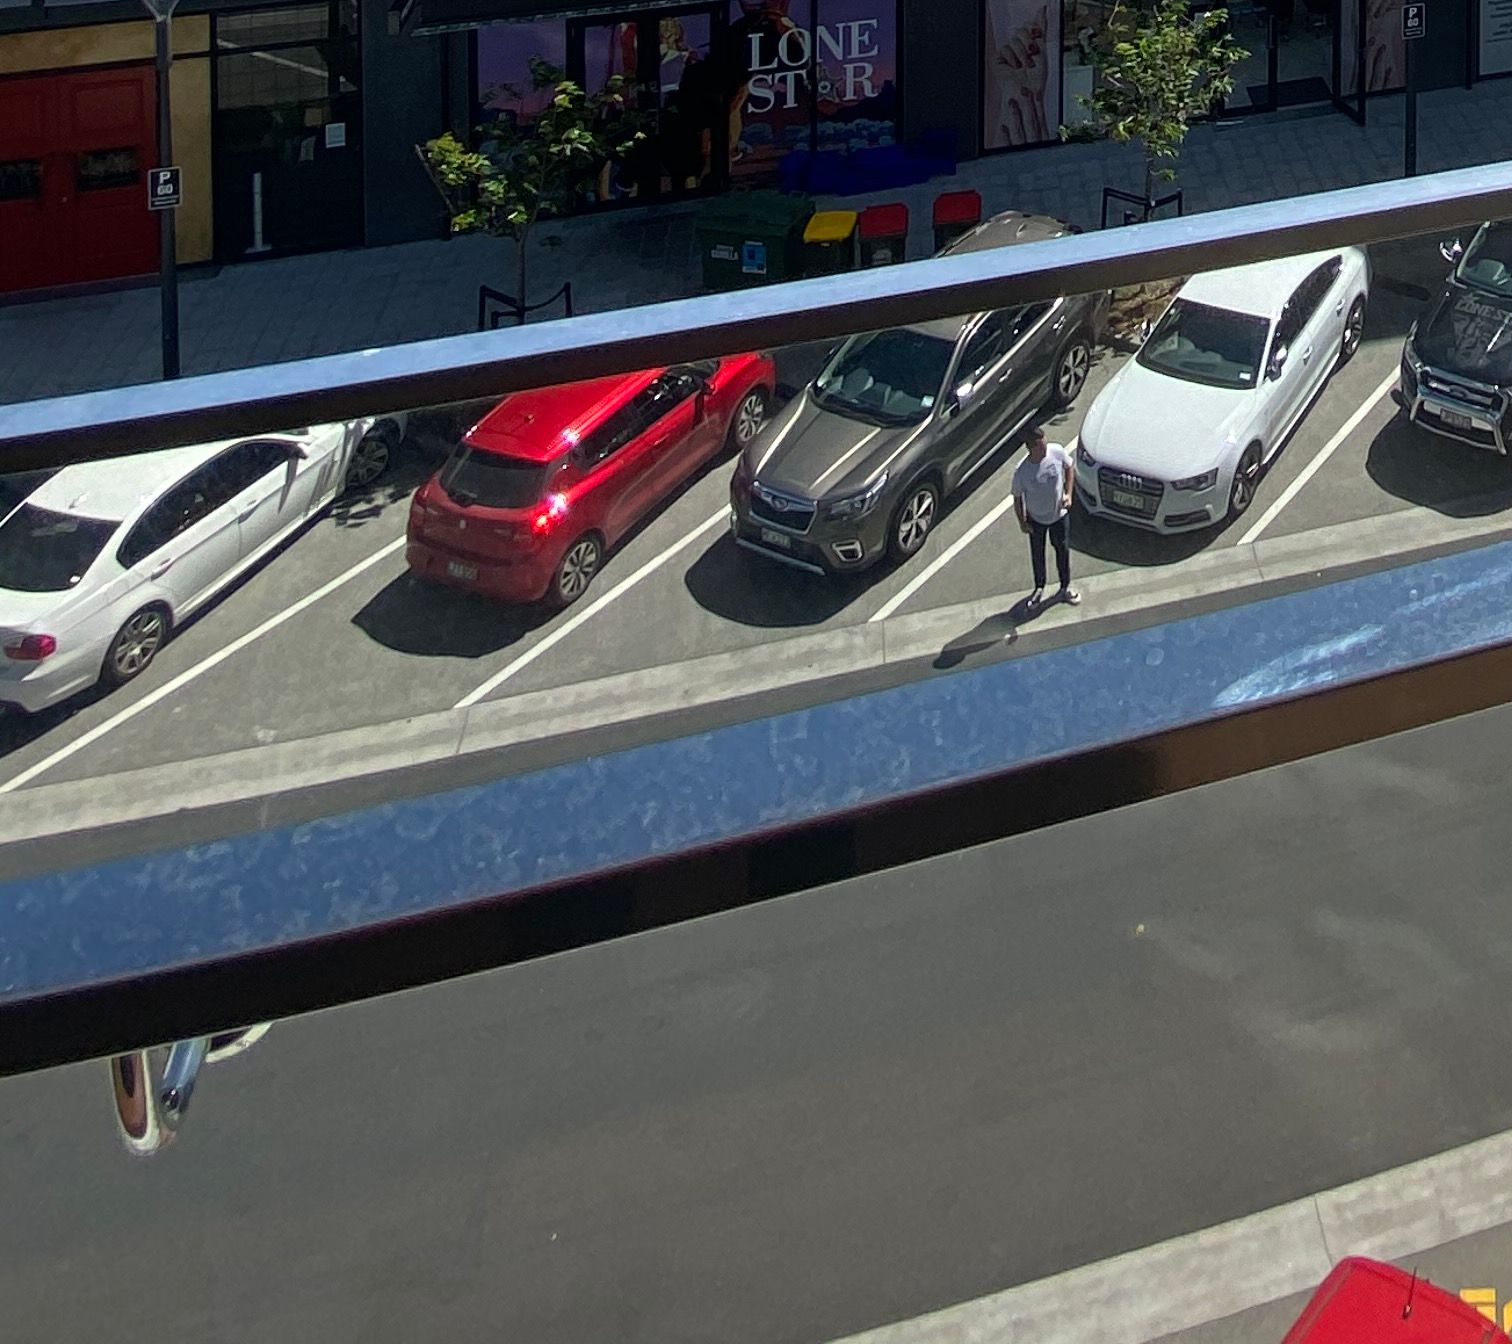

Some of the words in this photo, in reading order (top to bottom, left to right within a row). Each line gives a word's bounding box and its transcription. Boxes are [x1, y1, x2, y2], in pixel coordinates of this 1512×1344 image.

[1409, 7, 1418, 18] P
[747, 18, 879, 72] LONE
[160, 172, 171, 184] P
